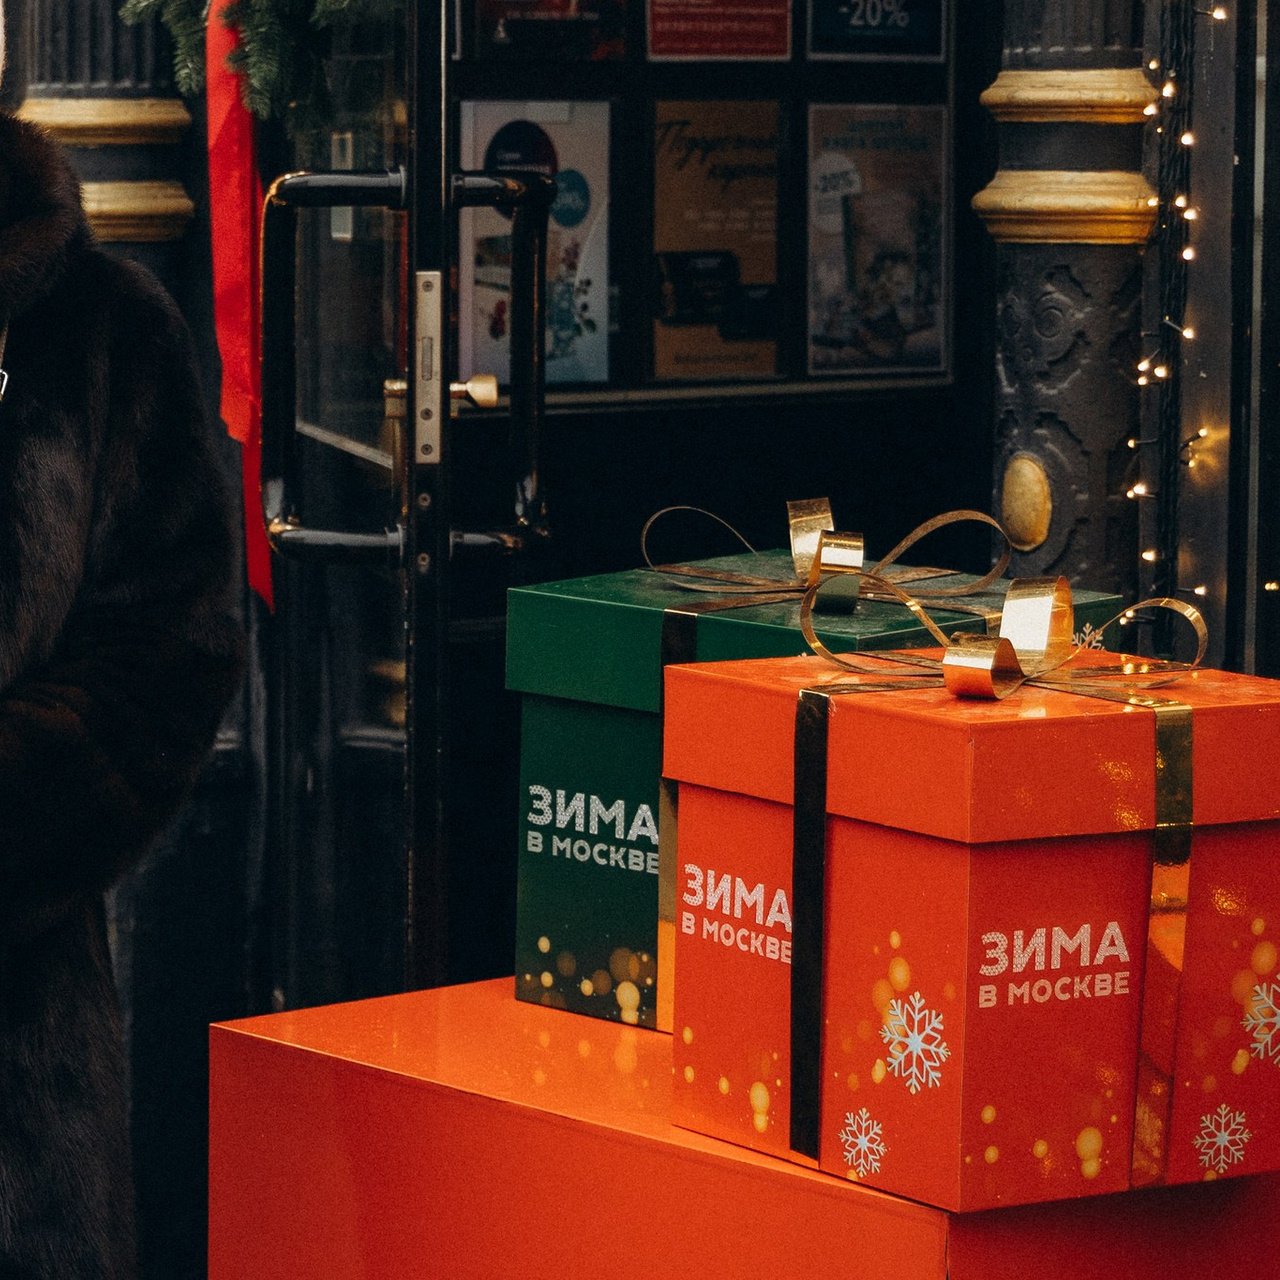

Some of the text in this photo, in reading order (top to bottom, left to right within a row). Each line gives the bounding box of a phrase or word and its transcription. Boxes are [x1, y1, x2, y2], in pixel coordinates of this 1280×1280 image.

[527, 784, 659, 846] ЗИМА
[527, 830, 659, 874] В МОСКВЕ
[682, 863, 793, 934] ЗИМА
[681, 911, 792, 965] В МОСКВЕ
[979, 921, 1131, 977] ЗИМА
[978, 971, 1131, 1009] В МОСКВЕ
